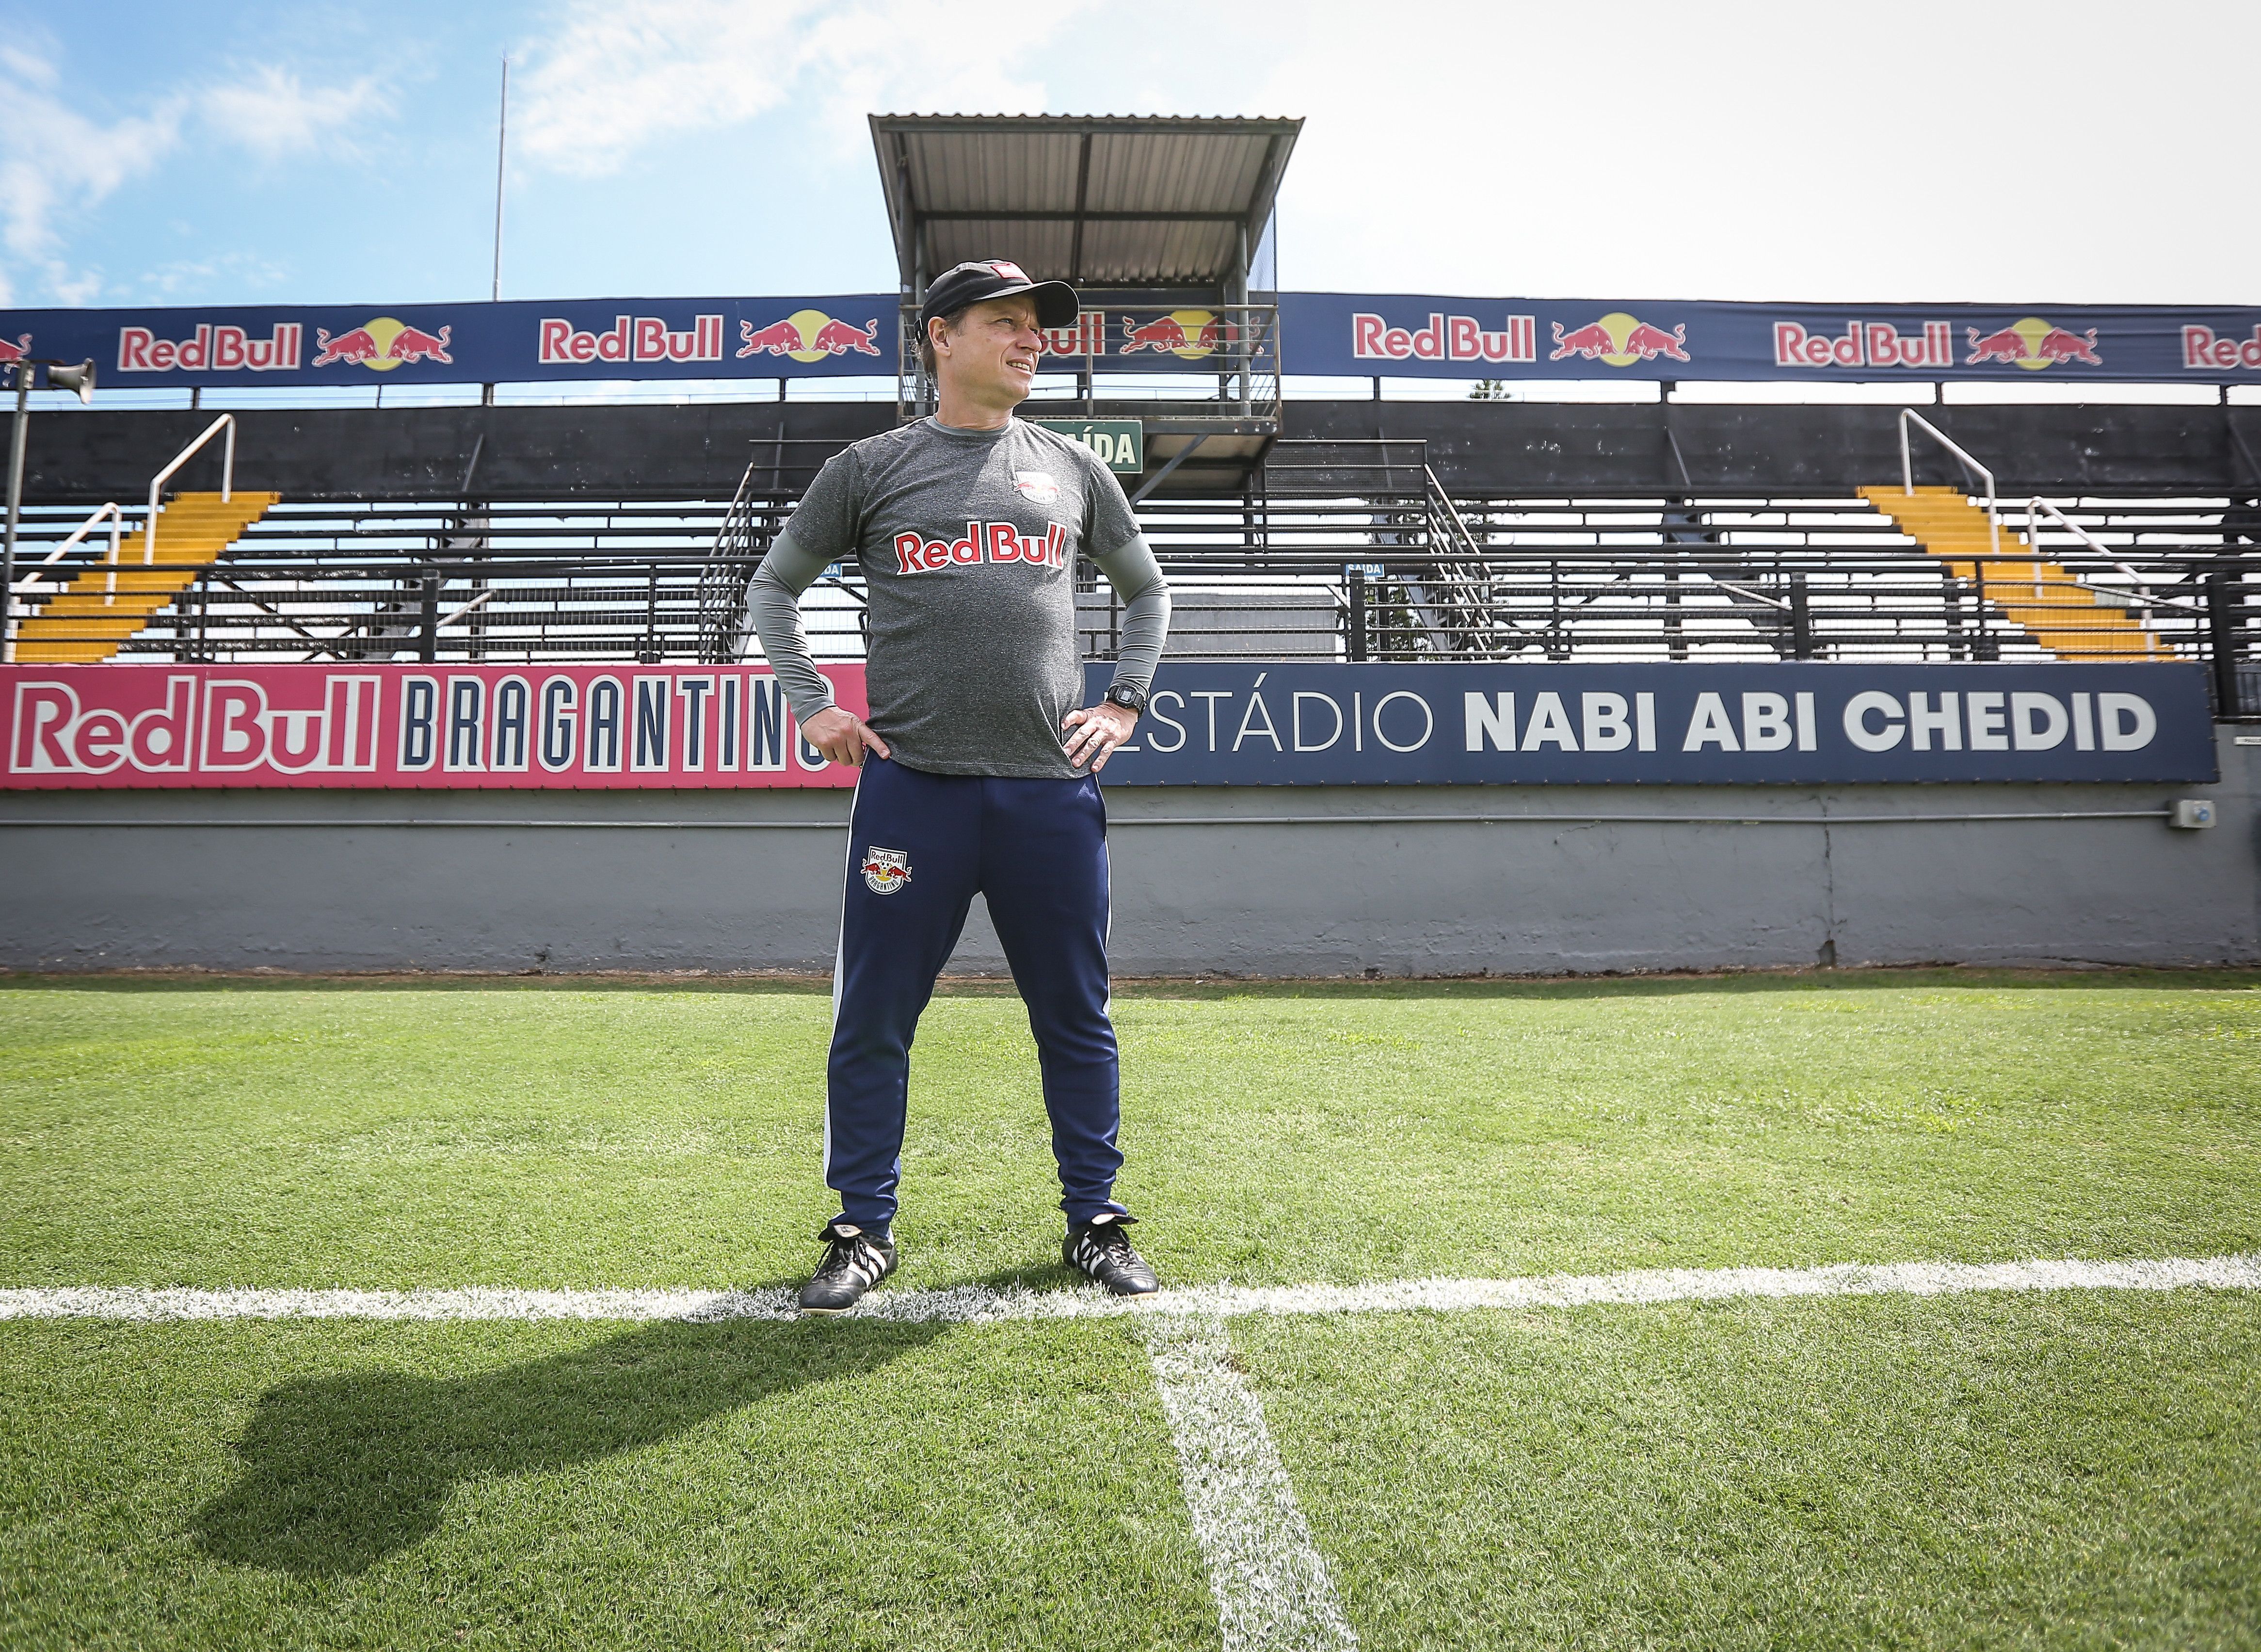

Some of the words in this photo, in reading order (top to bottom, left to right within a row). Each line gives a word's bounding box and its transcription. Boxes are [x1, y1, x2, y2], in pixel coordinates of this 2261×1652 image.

[118, 323, 212, 371] Red
[212, 322, 303, 371] Bull
[539, 315, 631, 364] Red
[633, 314, 723, 363] Bull
[1038, 311, 1105, 357] ull
[1352, 312, 1445, 361] Red
[1448, 315, 1537, 363] Bull
[1772, 320, 1865, 368] Red
[1866, 321, 1954, 368] Bull
[894, 521, 984, 576] Red
[986, 520, 1067, 570] Bull
[9, 674, 197, 775] Red
[198, 674, 382, 774] Bull
[1464, 691, 1657, 752] NABI
[1682, 691, 1818, 752] ABI
[1844, 690, 2158, 753] CHEDID
[871, 850, 886, 861] Red
[886, 853, 902, 864] Bull
[868, 876, 899, 891] BRAGANTINO
